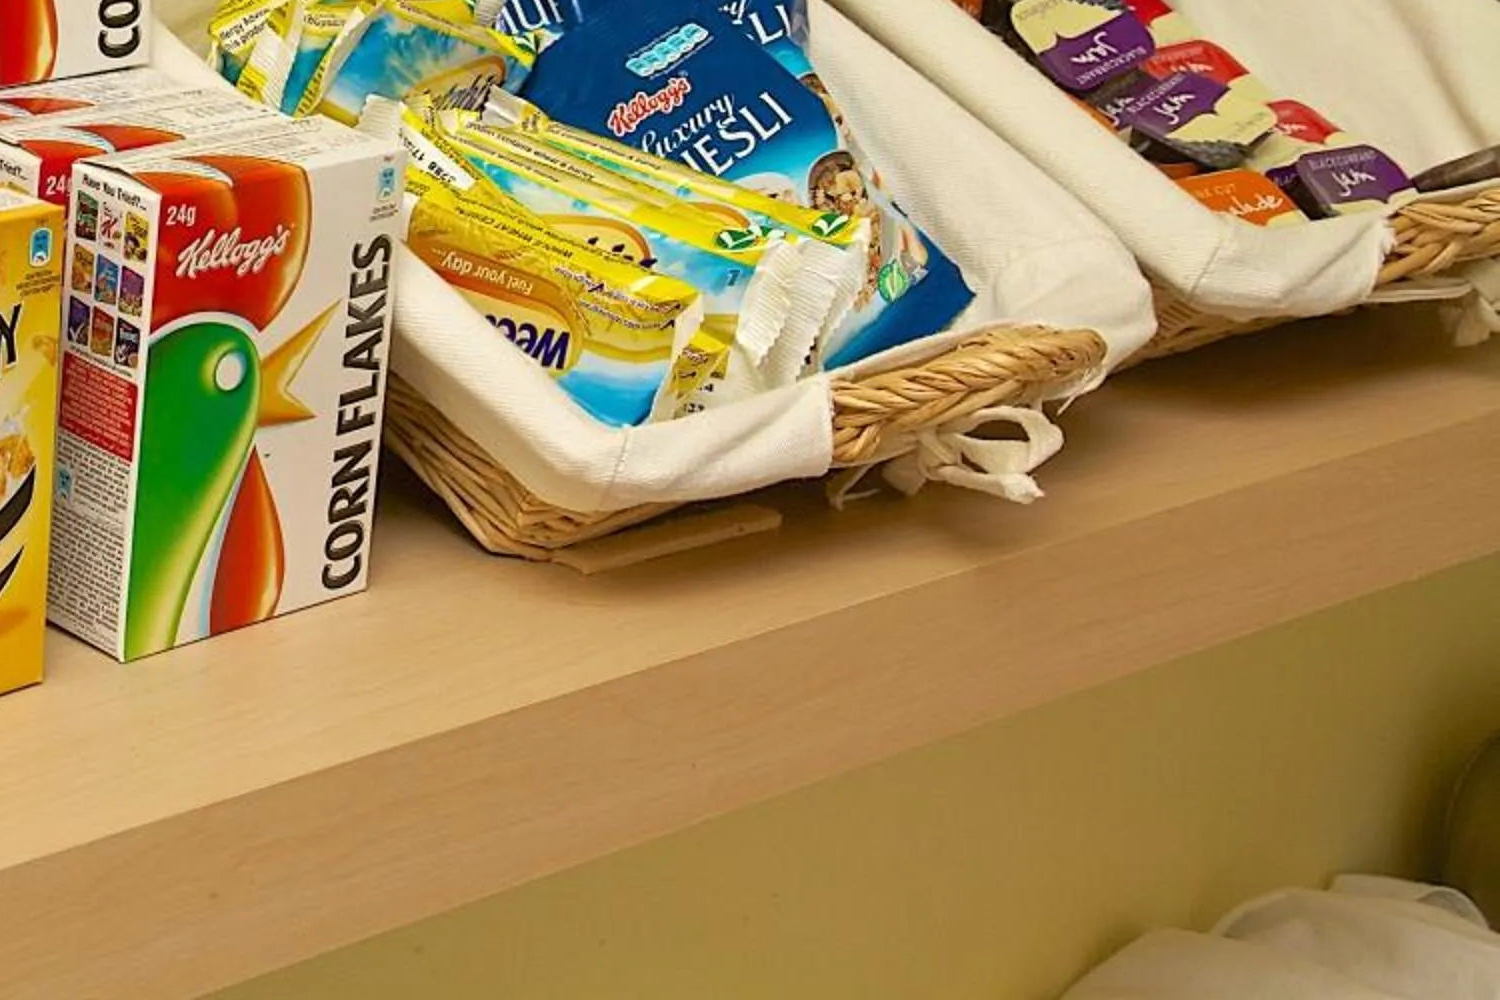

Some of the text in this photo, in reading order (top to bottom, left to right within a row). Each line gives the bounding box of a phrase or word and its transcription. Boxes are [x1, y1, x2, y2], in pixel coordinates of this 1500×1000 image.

[607, 77, 691, 136] Kellogg's
[166, 203, 197, 227] 24g
[176, 224, 290, 279] Kellogg's
[475, 265, 508, 286] your
[506, 278, 534, 297] Fuel
[336, 233, 394, 440] FLAKES
[321, 440, 376, 591] CORN
